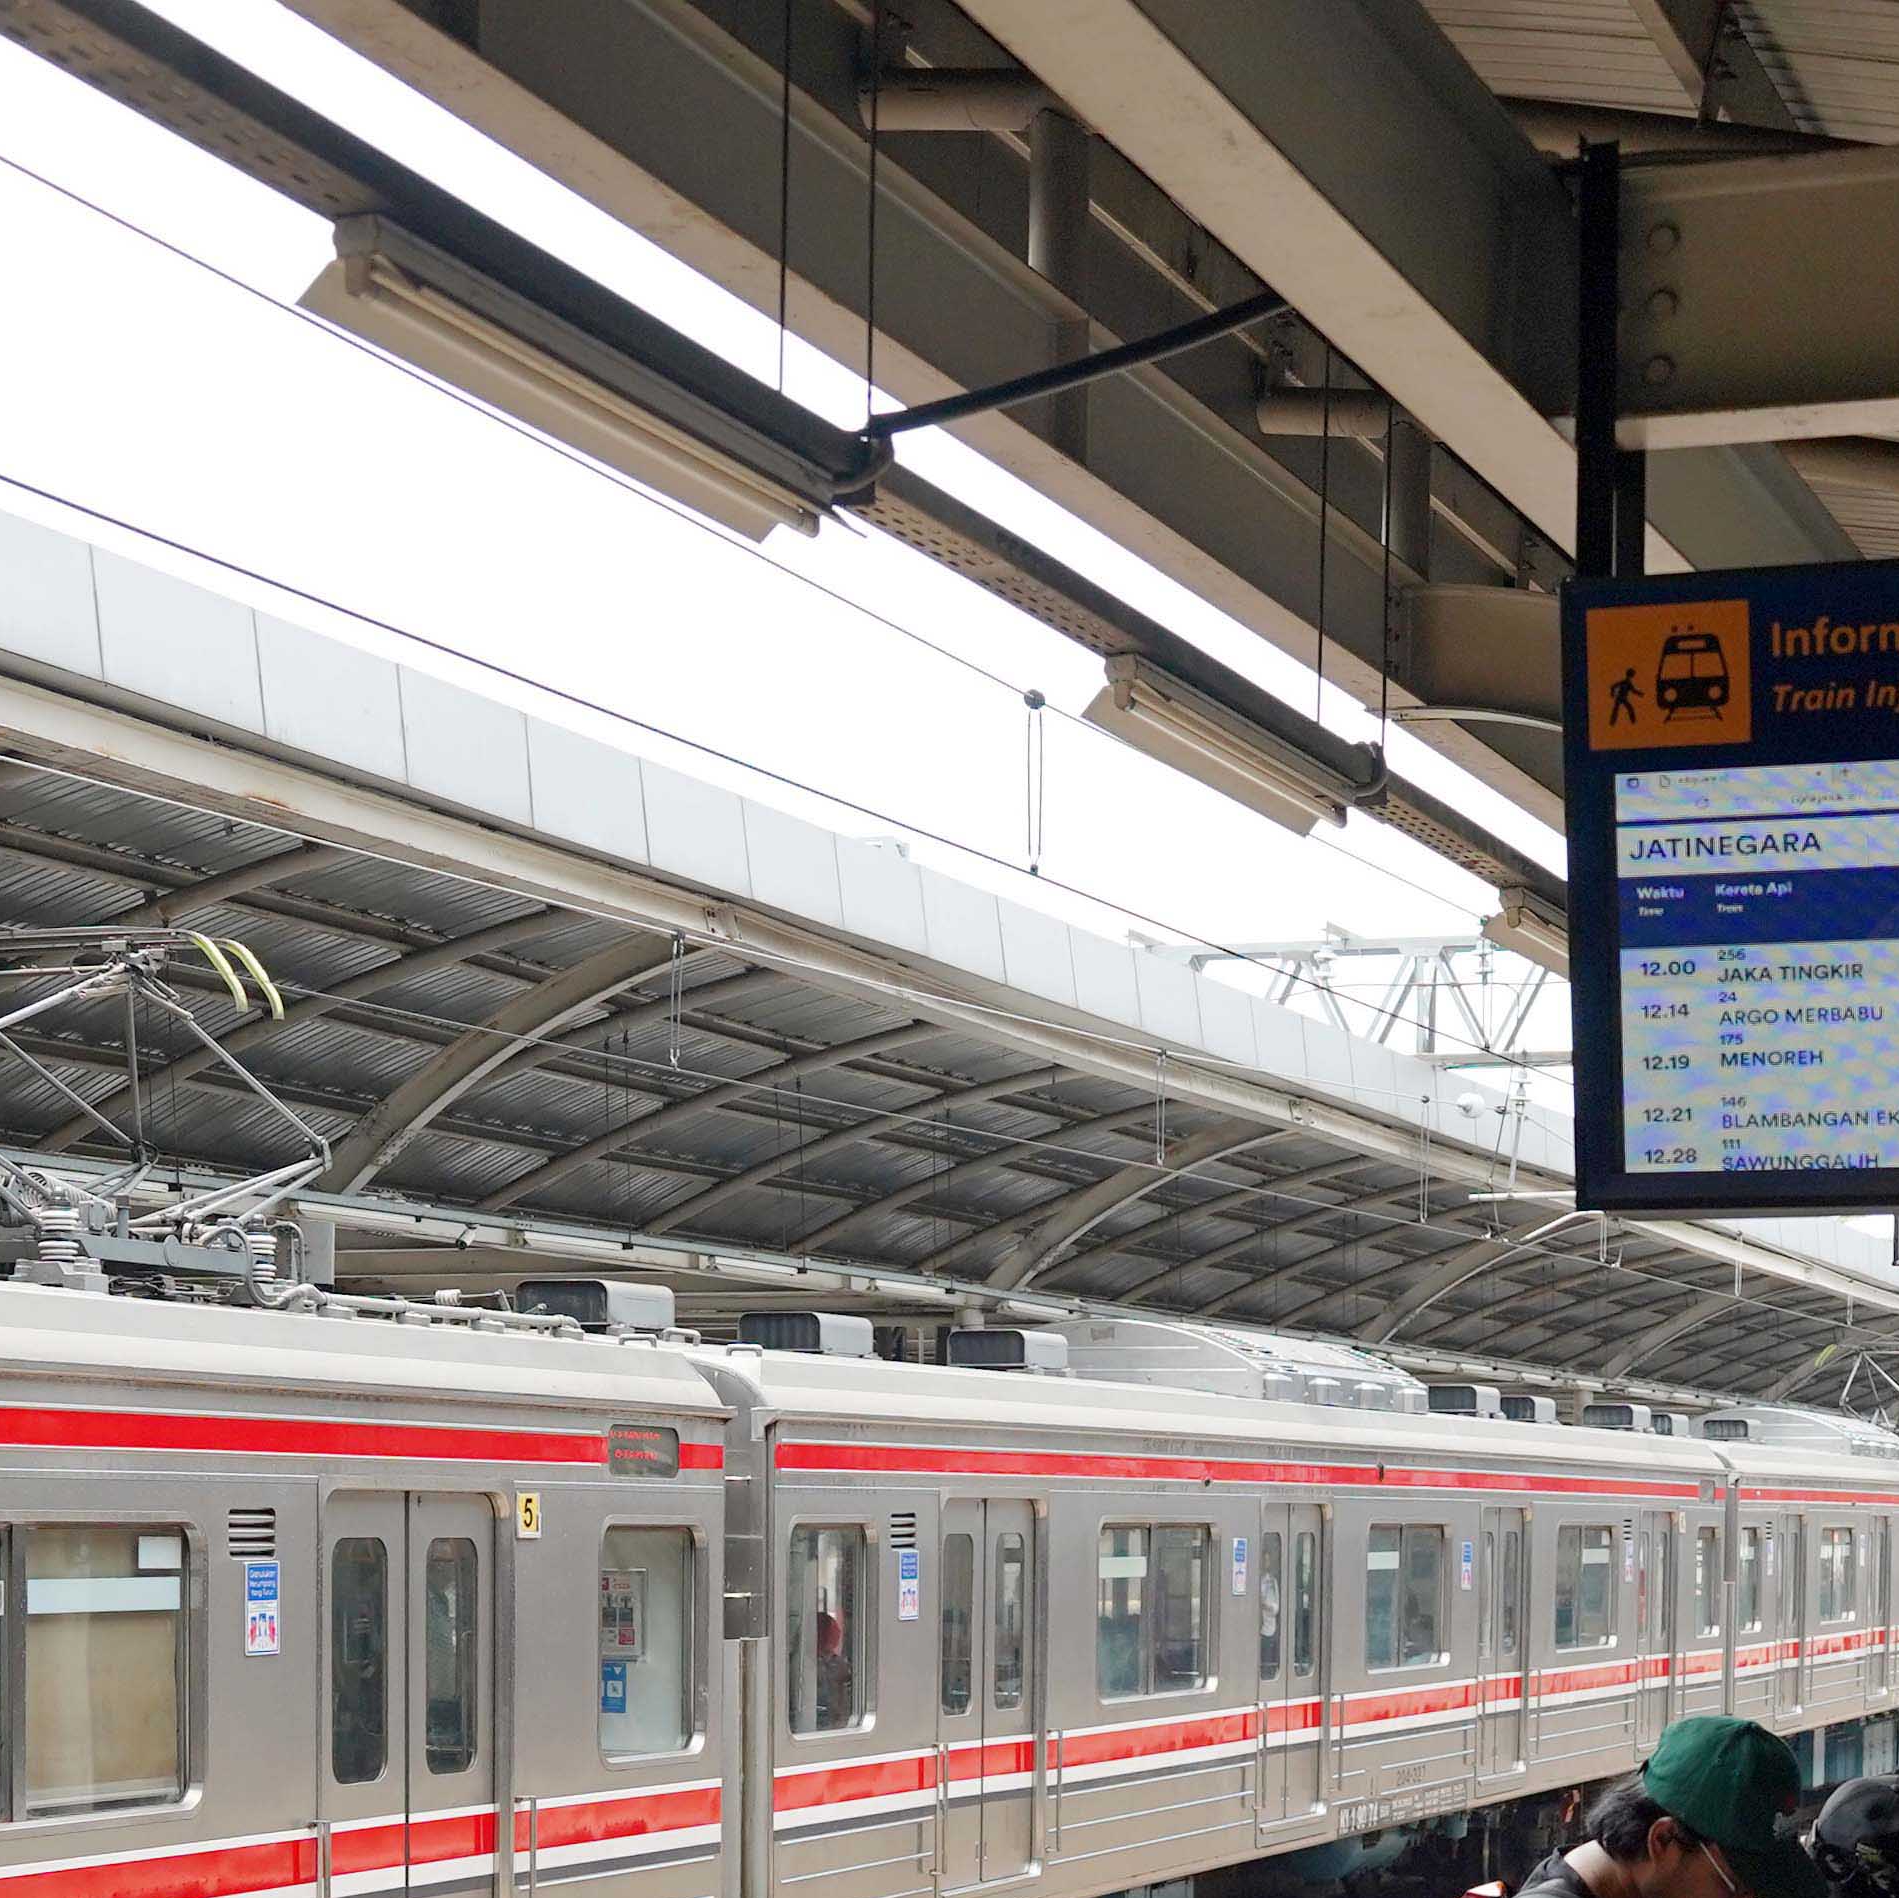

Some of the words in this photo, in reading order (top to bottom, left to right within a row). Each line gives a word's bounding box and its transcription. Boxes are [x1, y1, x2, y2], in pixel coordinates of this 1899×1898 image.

[1773, 681, 1855, 711] Train
[1629, 831, 1822, 860] JATINEGARA
[1718, 948, 1747, 962] 256
[1640, 961, 1697, 977] 12.00
[1718, 966, 1773, 983] JAKA
[1779, 963, 1864, 982] TINGKIR
[1718, 991, 1738, 1004] 24
[1641, 1004, 1690, 1020] 12.14
[1718, 1009, 1779, 1026] ARGO
[1785, 1006, 1884, 1023] MERBABU
[1720, 1033, 1743, 1045] 175
[1643, 1055, 1690, 1071] 12.19
[1719, 1050, 1824, 1068] MENOREH
[1643, 1107, 1693, 1123] 12.21
[1721, 1111, 1869, 1129] BLAMBANGAN
[1722, 1138, 1741, 1151] 111
[1644, 1148, 1698, 1164] 12.28
[1722, 1153, 1879, 1171] SAWUNGGALIH
[523, 1498, 533, 1527] 5
